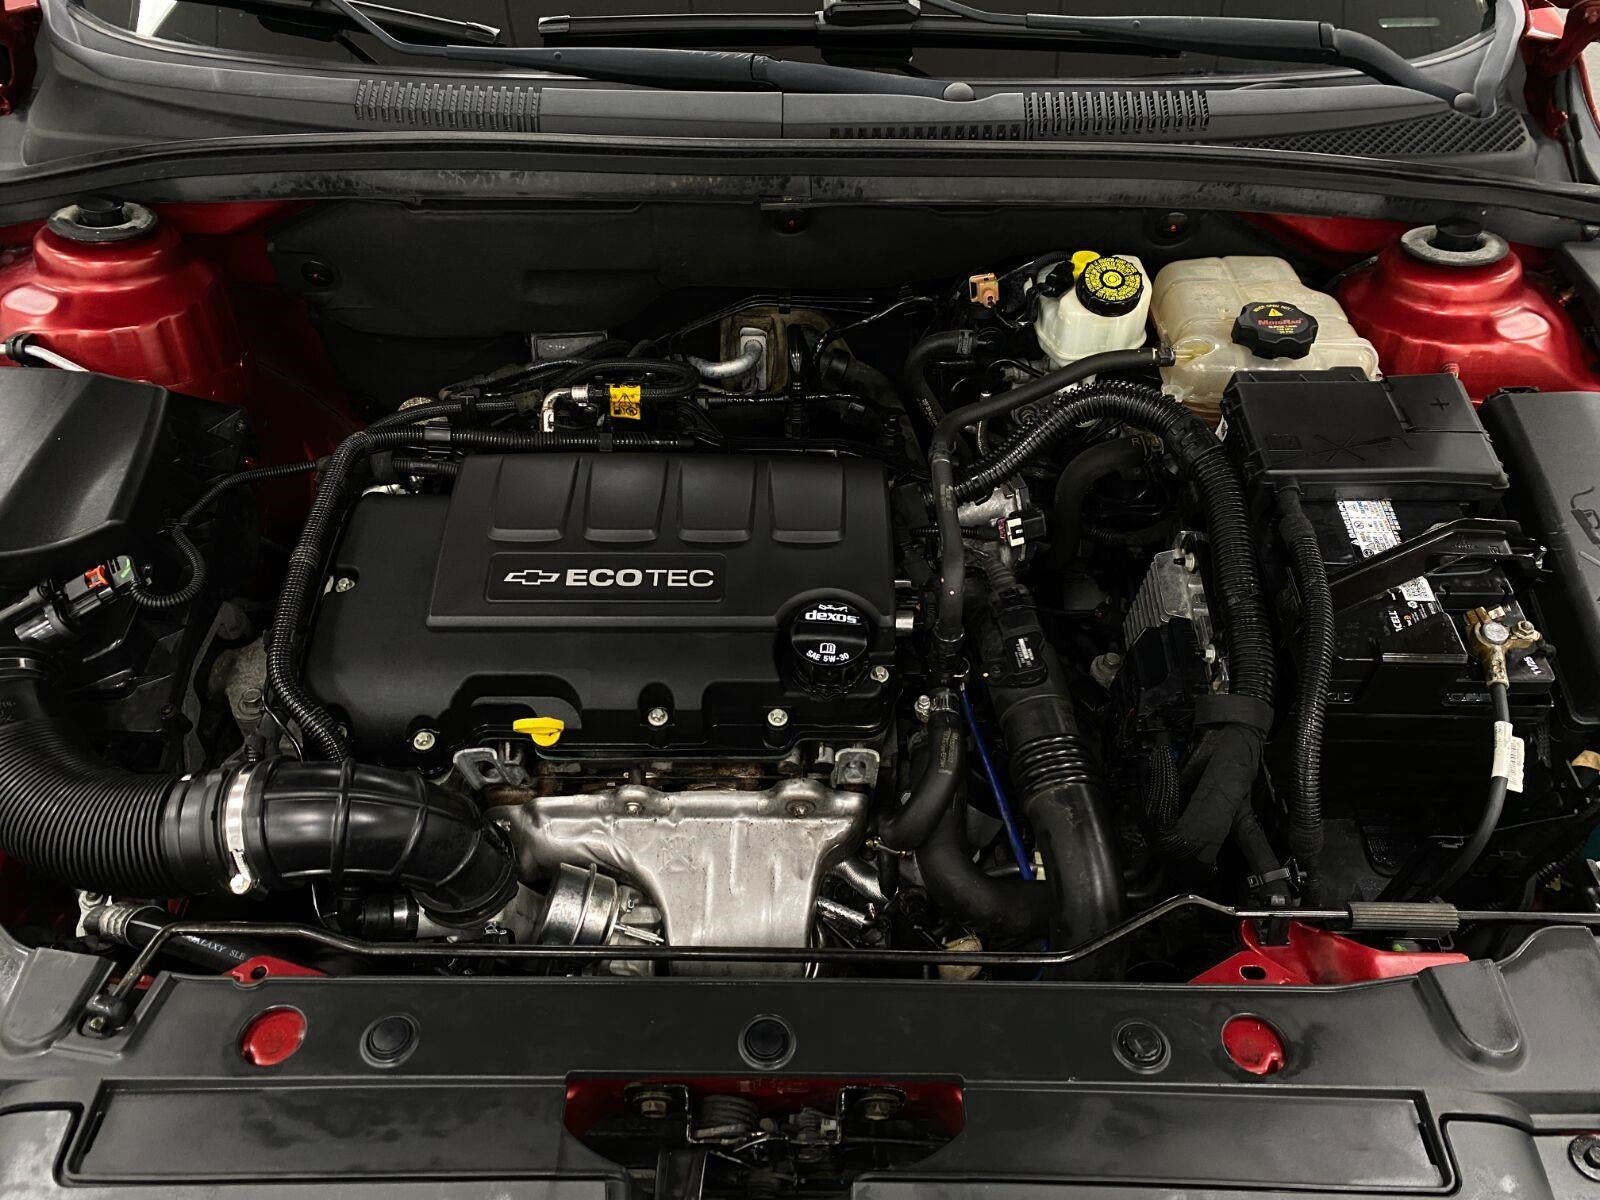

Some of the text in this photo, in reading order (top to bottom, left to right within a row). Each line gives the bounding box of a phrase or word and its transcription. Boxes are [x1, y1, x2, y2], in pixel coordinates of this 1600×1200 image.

[565, 568, 714, 587] ECOTEC
[804, 609, 859, 624] dexos
[806, 649, 850, 663] SAE 5W-30
